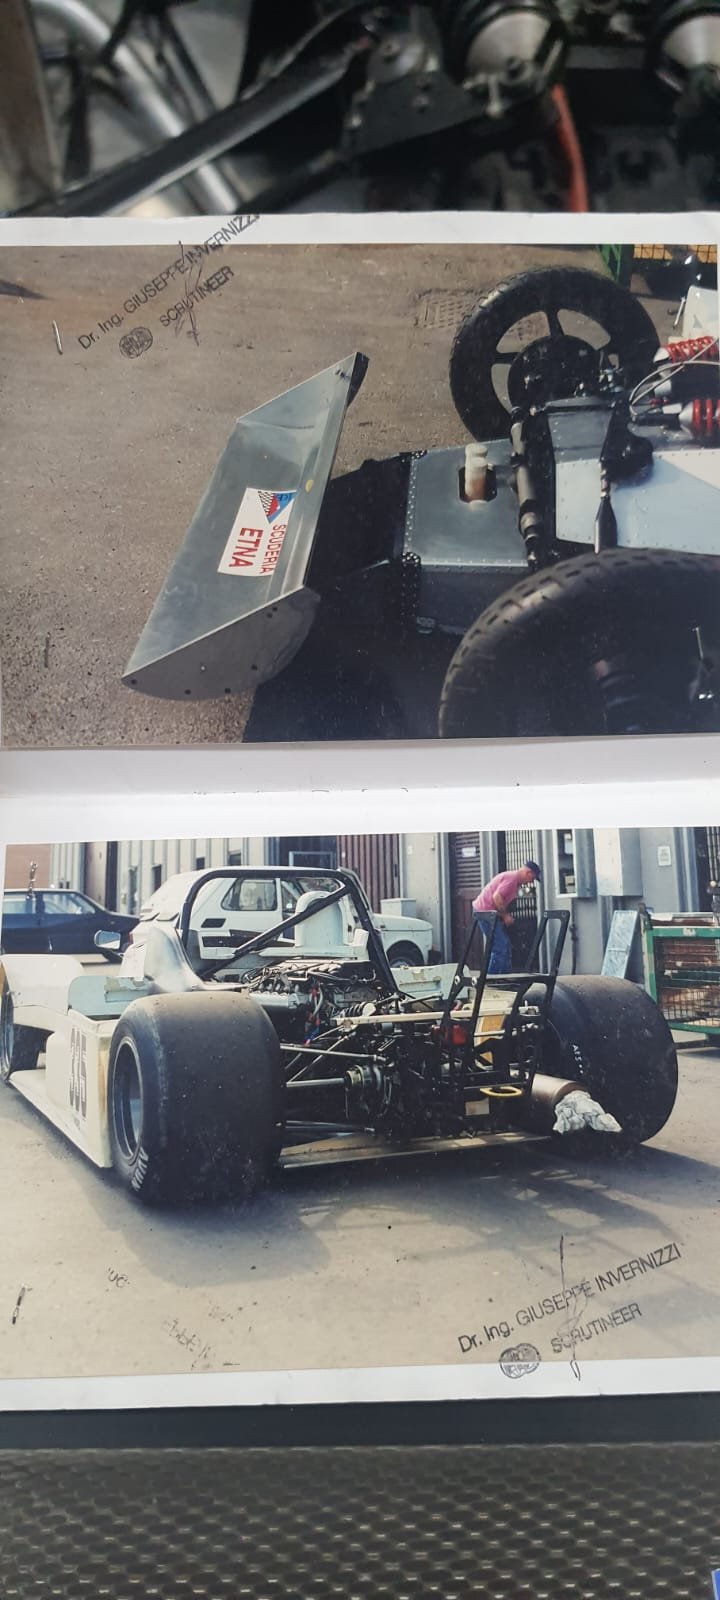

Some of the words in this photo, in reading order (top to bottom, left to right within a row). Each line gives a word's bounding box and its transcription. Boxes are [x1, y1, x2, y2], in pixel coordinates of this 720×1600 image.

[78, 334, 99, 349] Dr.
[97, 314, 124, 334] Ing.
[123, 258, 189, 314] GIUSEPPE
[160, 265, 235, 327] SCRUTINEER
[228, 527, 264, 568] ETNA
[260, 524, 286, 574] SCUDERIA
[458, 1335, 482, 1353] Dr.
[483, 1320, 514, 1338] Ing.
[515, 1283, 598, 1326] GIUSEPPE
[594, 1242, 682, 1292] INVERNIZZI
[551, 1302, 643, 1354] SCRUTINEER
